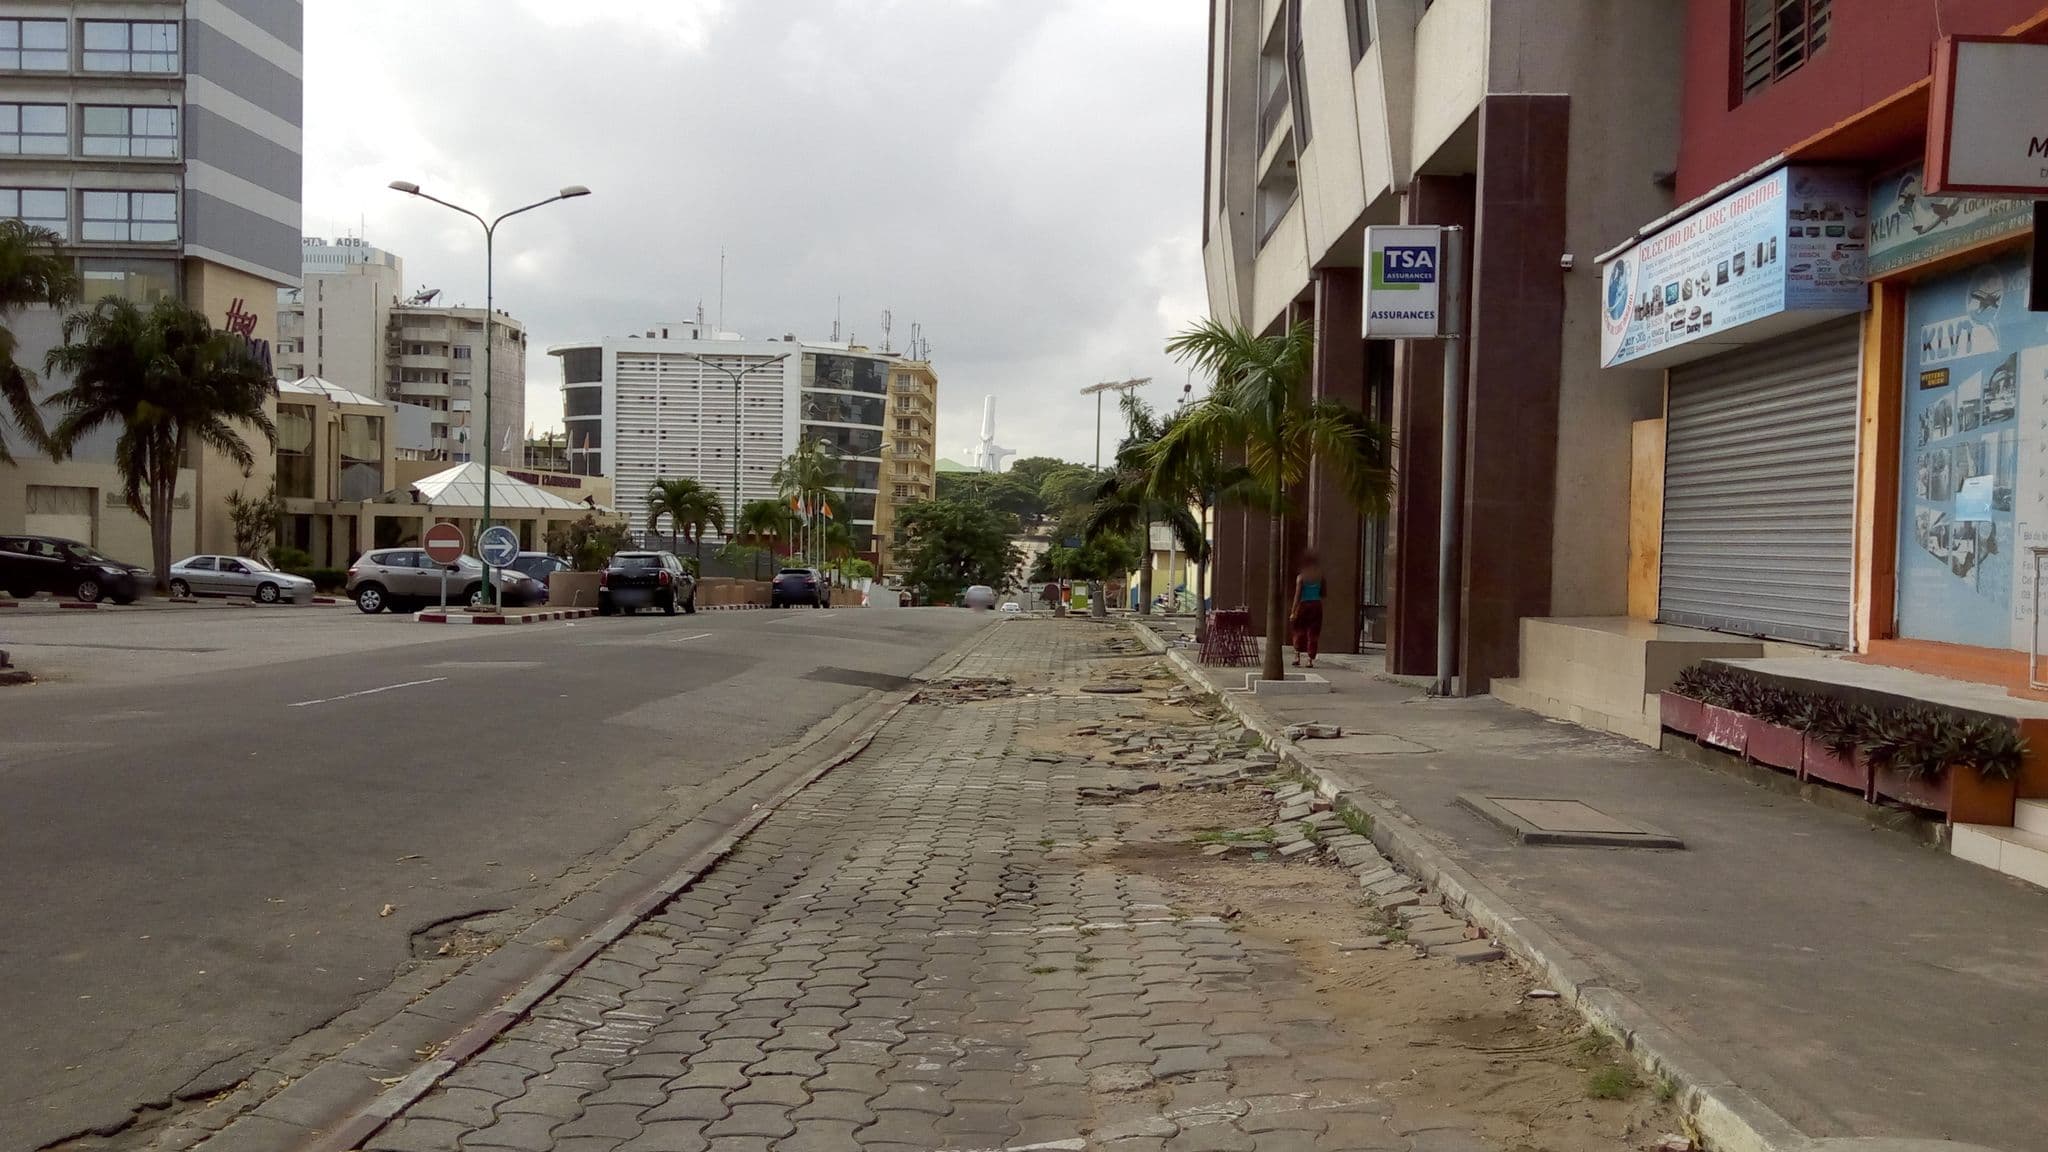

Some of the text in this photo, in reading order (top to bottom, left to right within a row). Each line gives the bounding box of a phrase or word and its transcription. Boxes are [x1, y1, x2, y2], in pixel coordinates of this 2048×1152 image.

[1683, 222, 1696, 241] DE
[1699, 207, 1727, 234] LUXE
[1729, 178, 1783, 217] ORIGINAL
[1871, 213, 1901, 244] KLVT
[1386, 250, 1433, 268] TSA
[1371, 310, 1435, 320] ASSURANCES
[1922, 320, 1974, 363] KLVT
